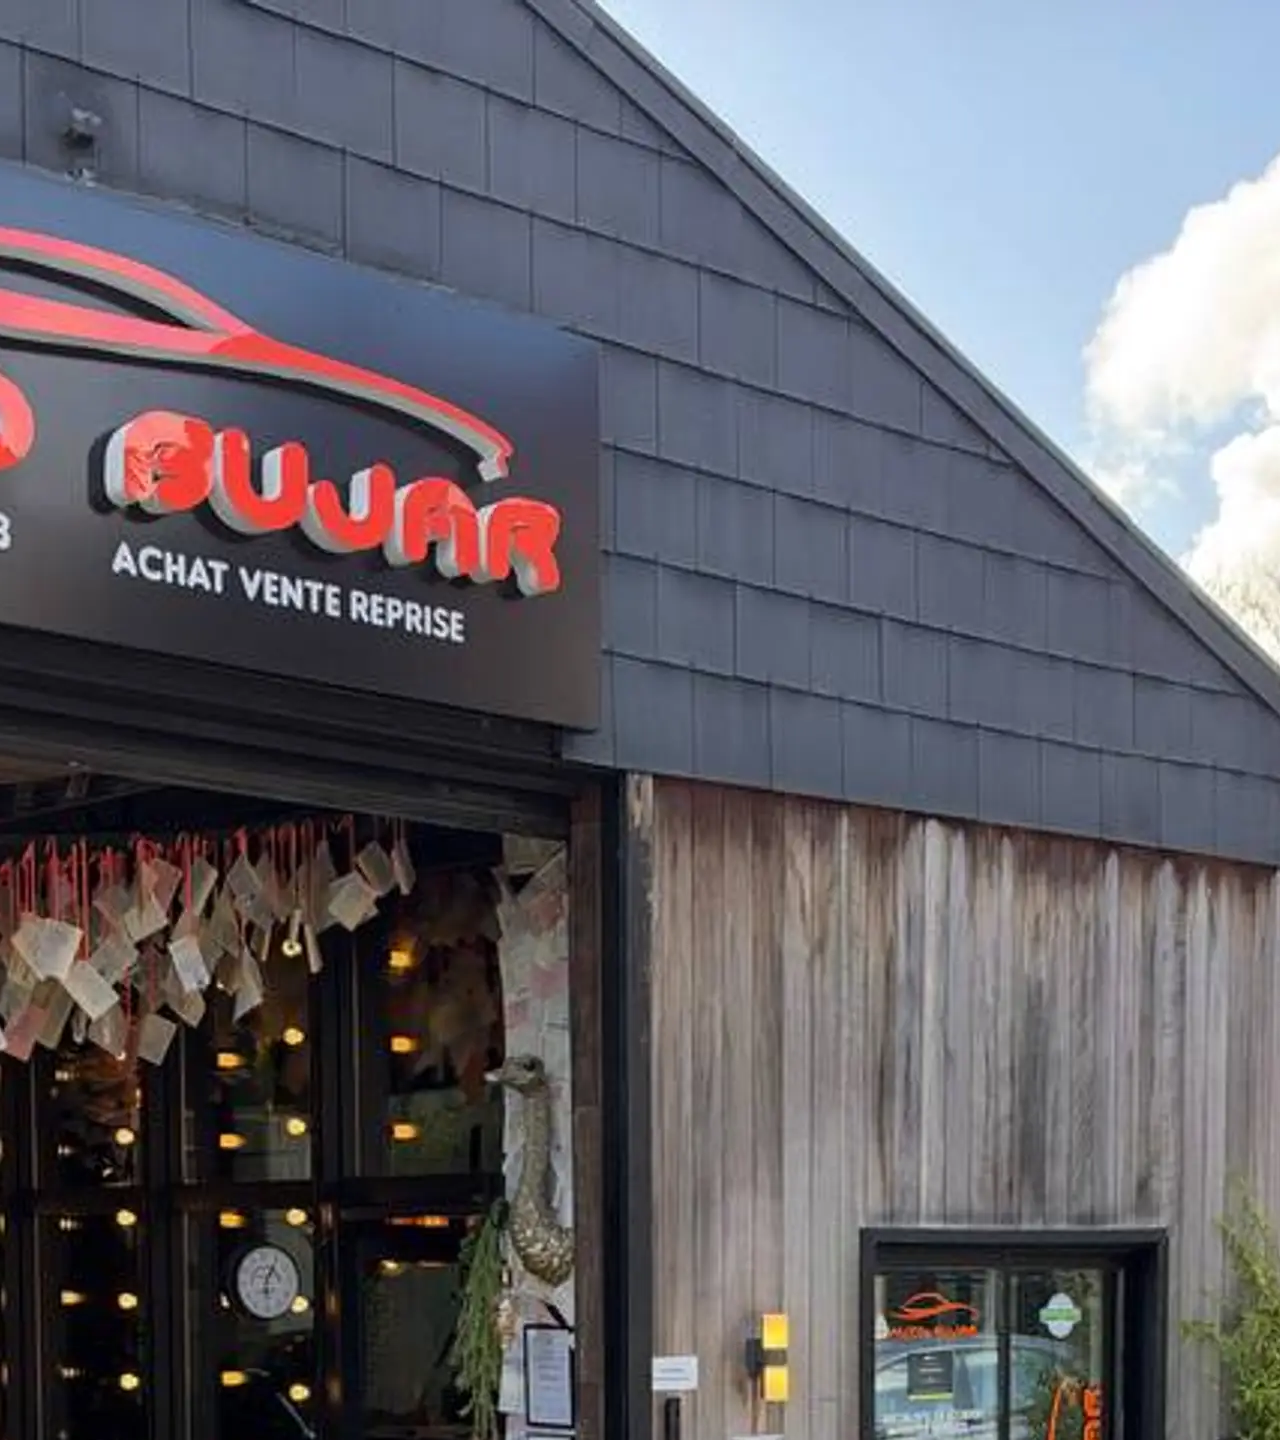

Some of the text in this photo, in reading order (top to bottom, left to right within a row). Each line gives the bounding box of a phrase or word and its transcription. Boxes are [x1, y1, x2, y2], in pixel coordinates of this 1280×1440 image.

[105, 409, 561, 595] BUJAR
[112, 541, 465, 643] ACHAT VENTE REPRISE
